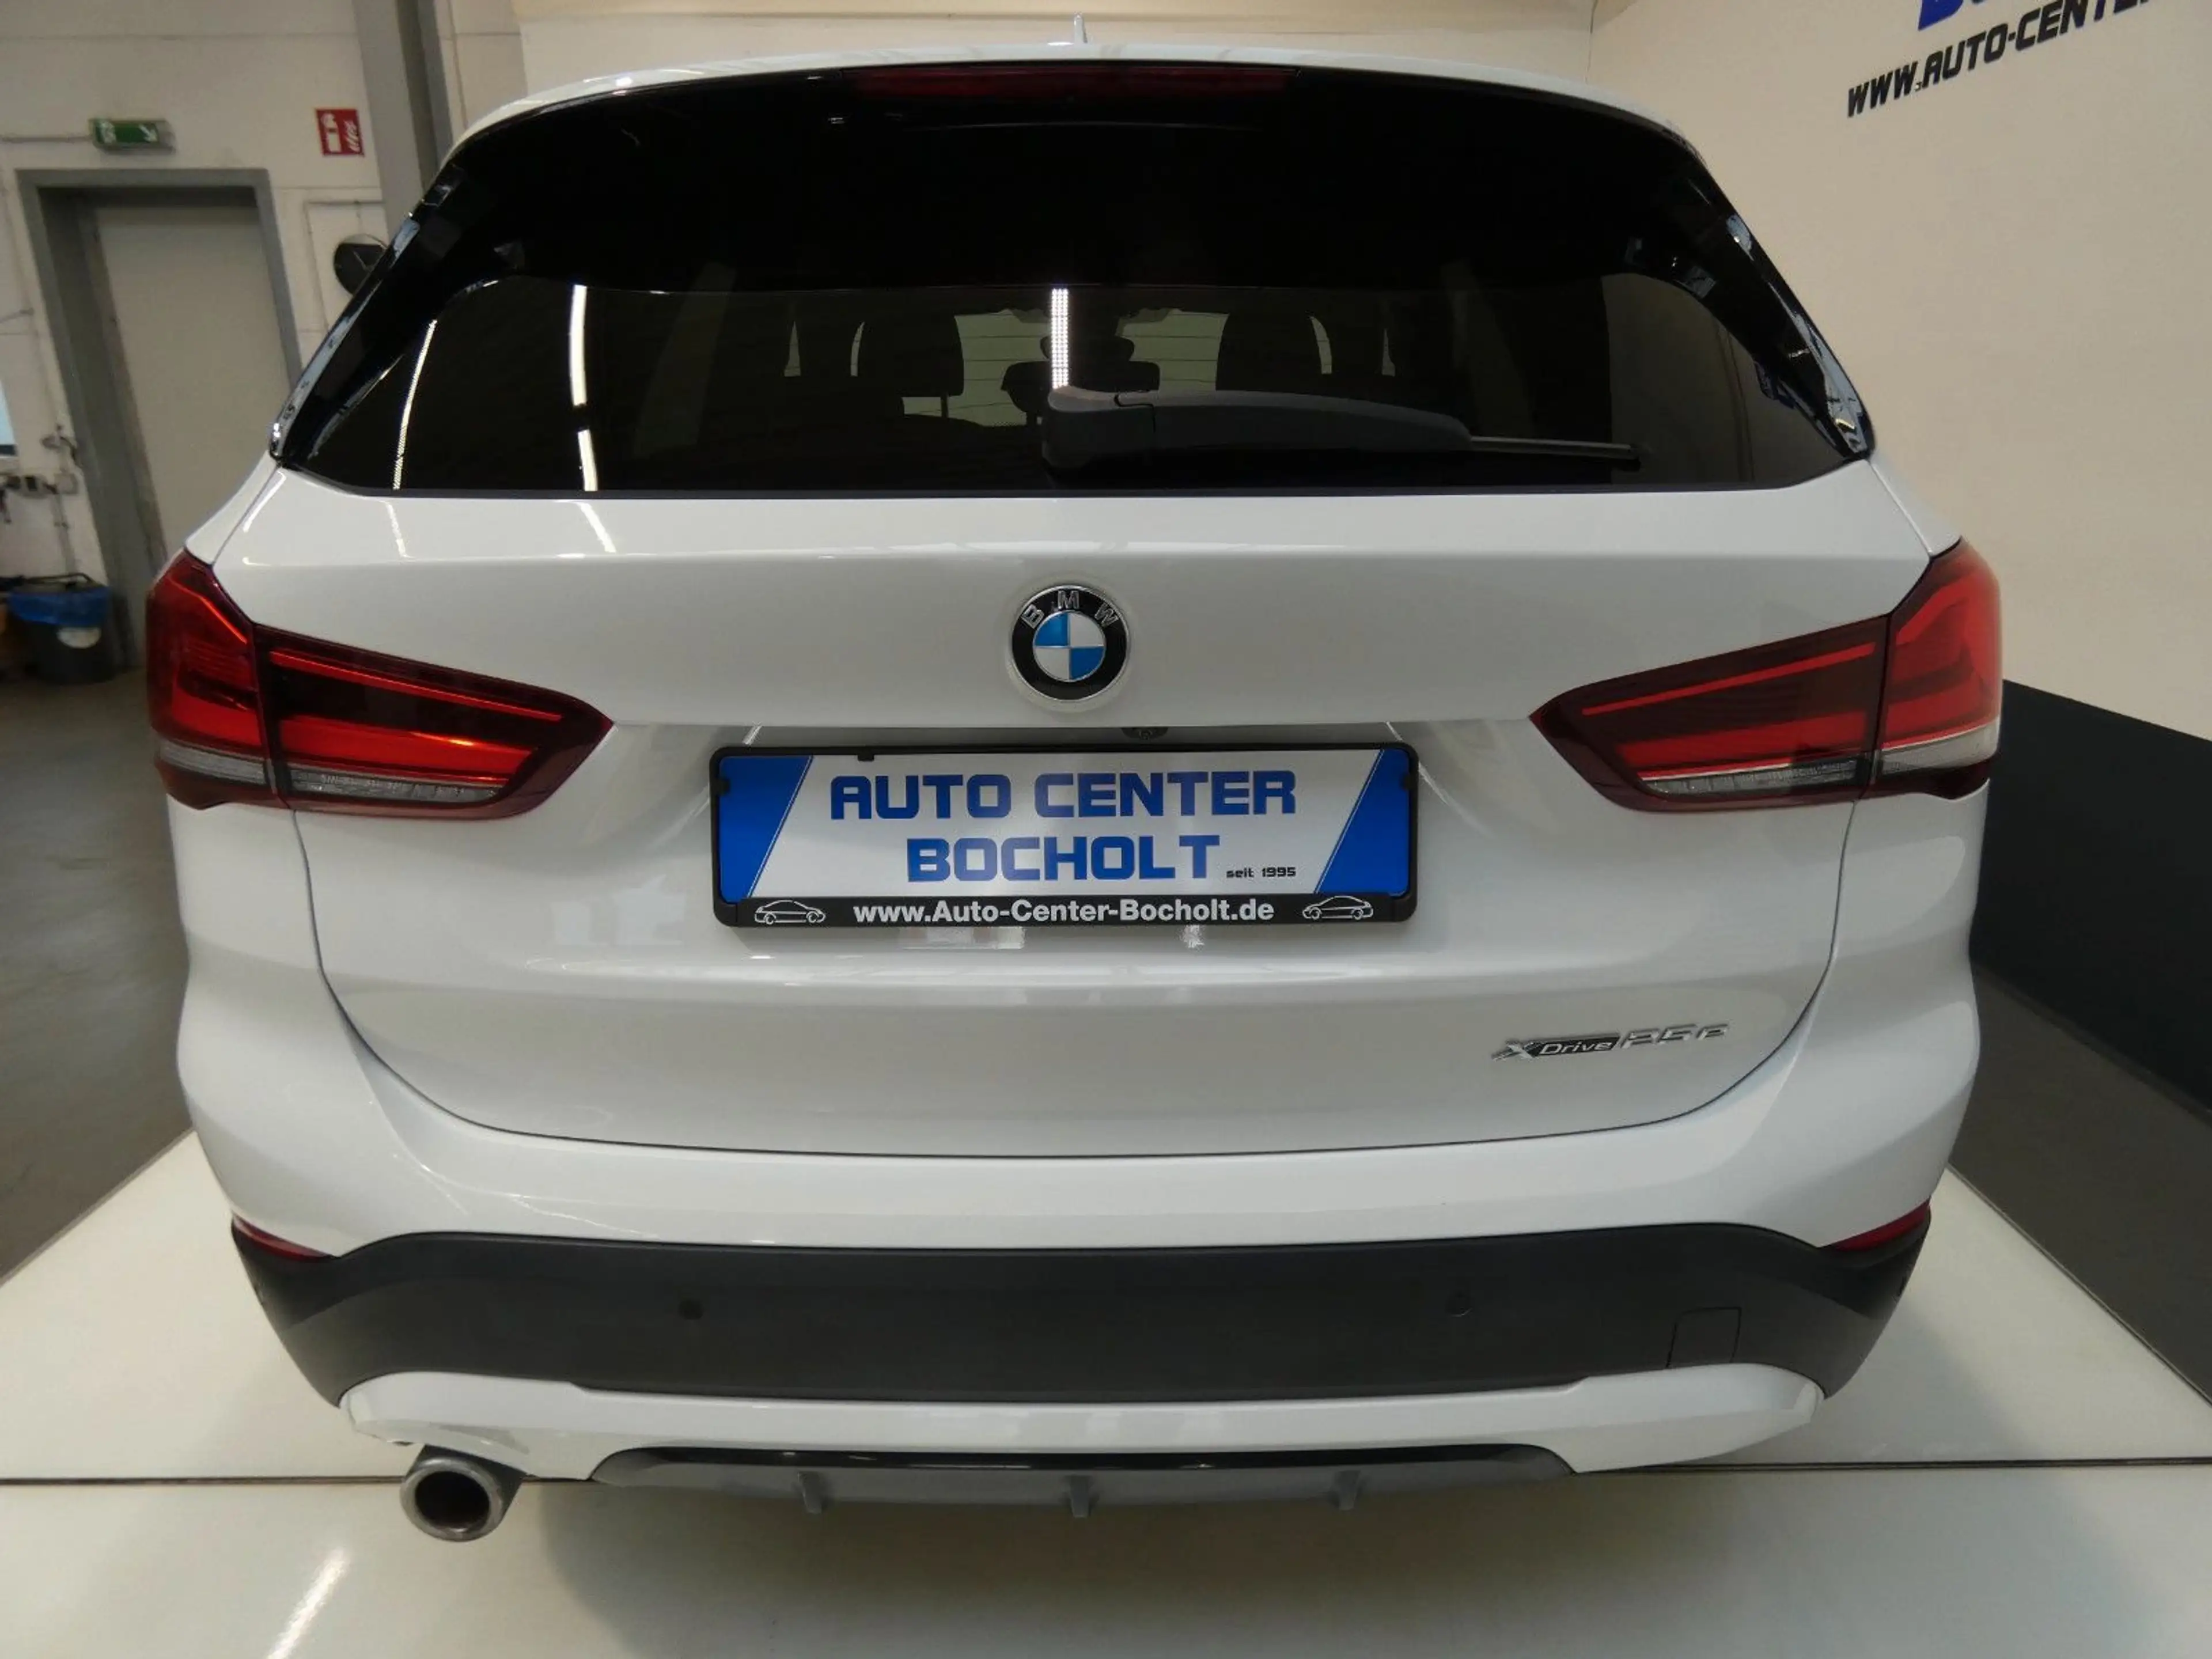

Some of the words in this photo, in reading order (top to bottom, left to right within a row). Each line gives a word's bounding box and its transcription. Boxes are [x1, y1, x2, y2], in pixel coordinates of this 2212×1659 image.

[1021, 590, 1119, 629] BMW
[831, 774, 1011, 820] AUTO
[1035, 770, 1296, 818] CENTER
[907, 835, 1219, 882] BOCHOLT
[1226, 867, 1255, 878] seit
[1262, 866, 1296, 877] 1995
[853, 899, 1274, 923] www.Auto-Center-Bocholt.de
